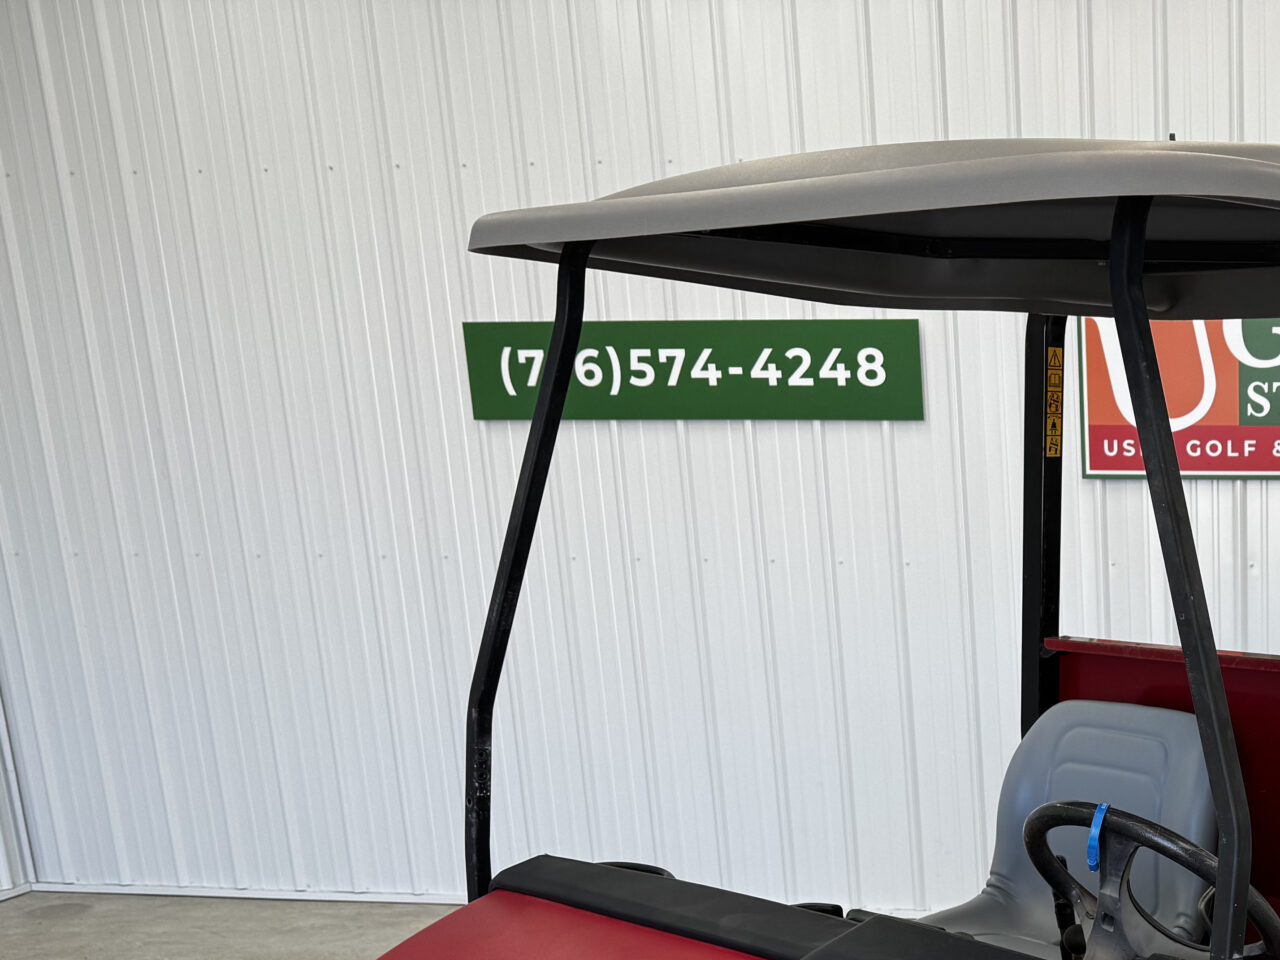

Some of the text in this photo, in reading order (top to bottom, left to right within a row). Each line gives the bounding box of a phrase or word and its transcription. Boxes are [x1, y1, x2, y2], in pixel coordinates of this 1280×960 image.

[499, 346, 888, 396] (76)574-4248
[1103, 439, 1143, 457] US
[1186, 439, 1257, 457] GOLF
